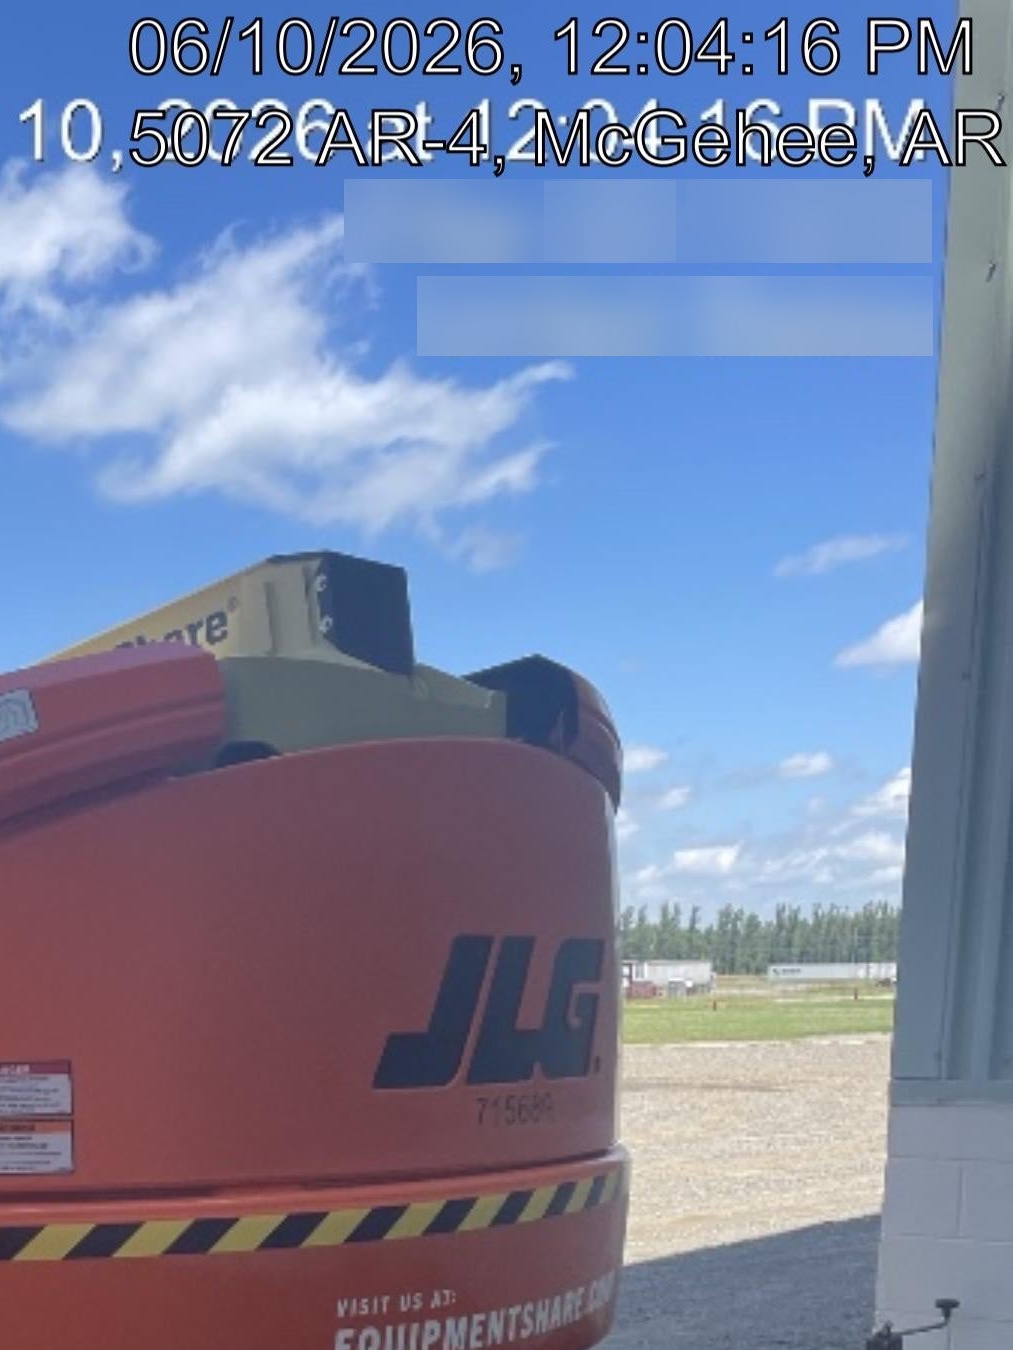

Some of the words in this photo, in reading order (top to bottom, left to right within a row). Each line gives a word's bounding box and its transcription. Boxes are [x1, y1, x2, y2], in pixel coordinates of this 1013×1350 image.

[372, 934, 605, 1089] JLG
[337, 1296, 390, 1317] VISIT
[400, 1292, 423, 1312] US
